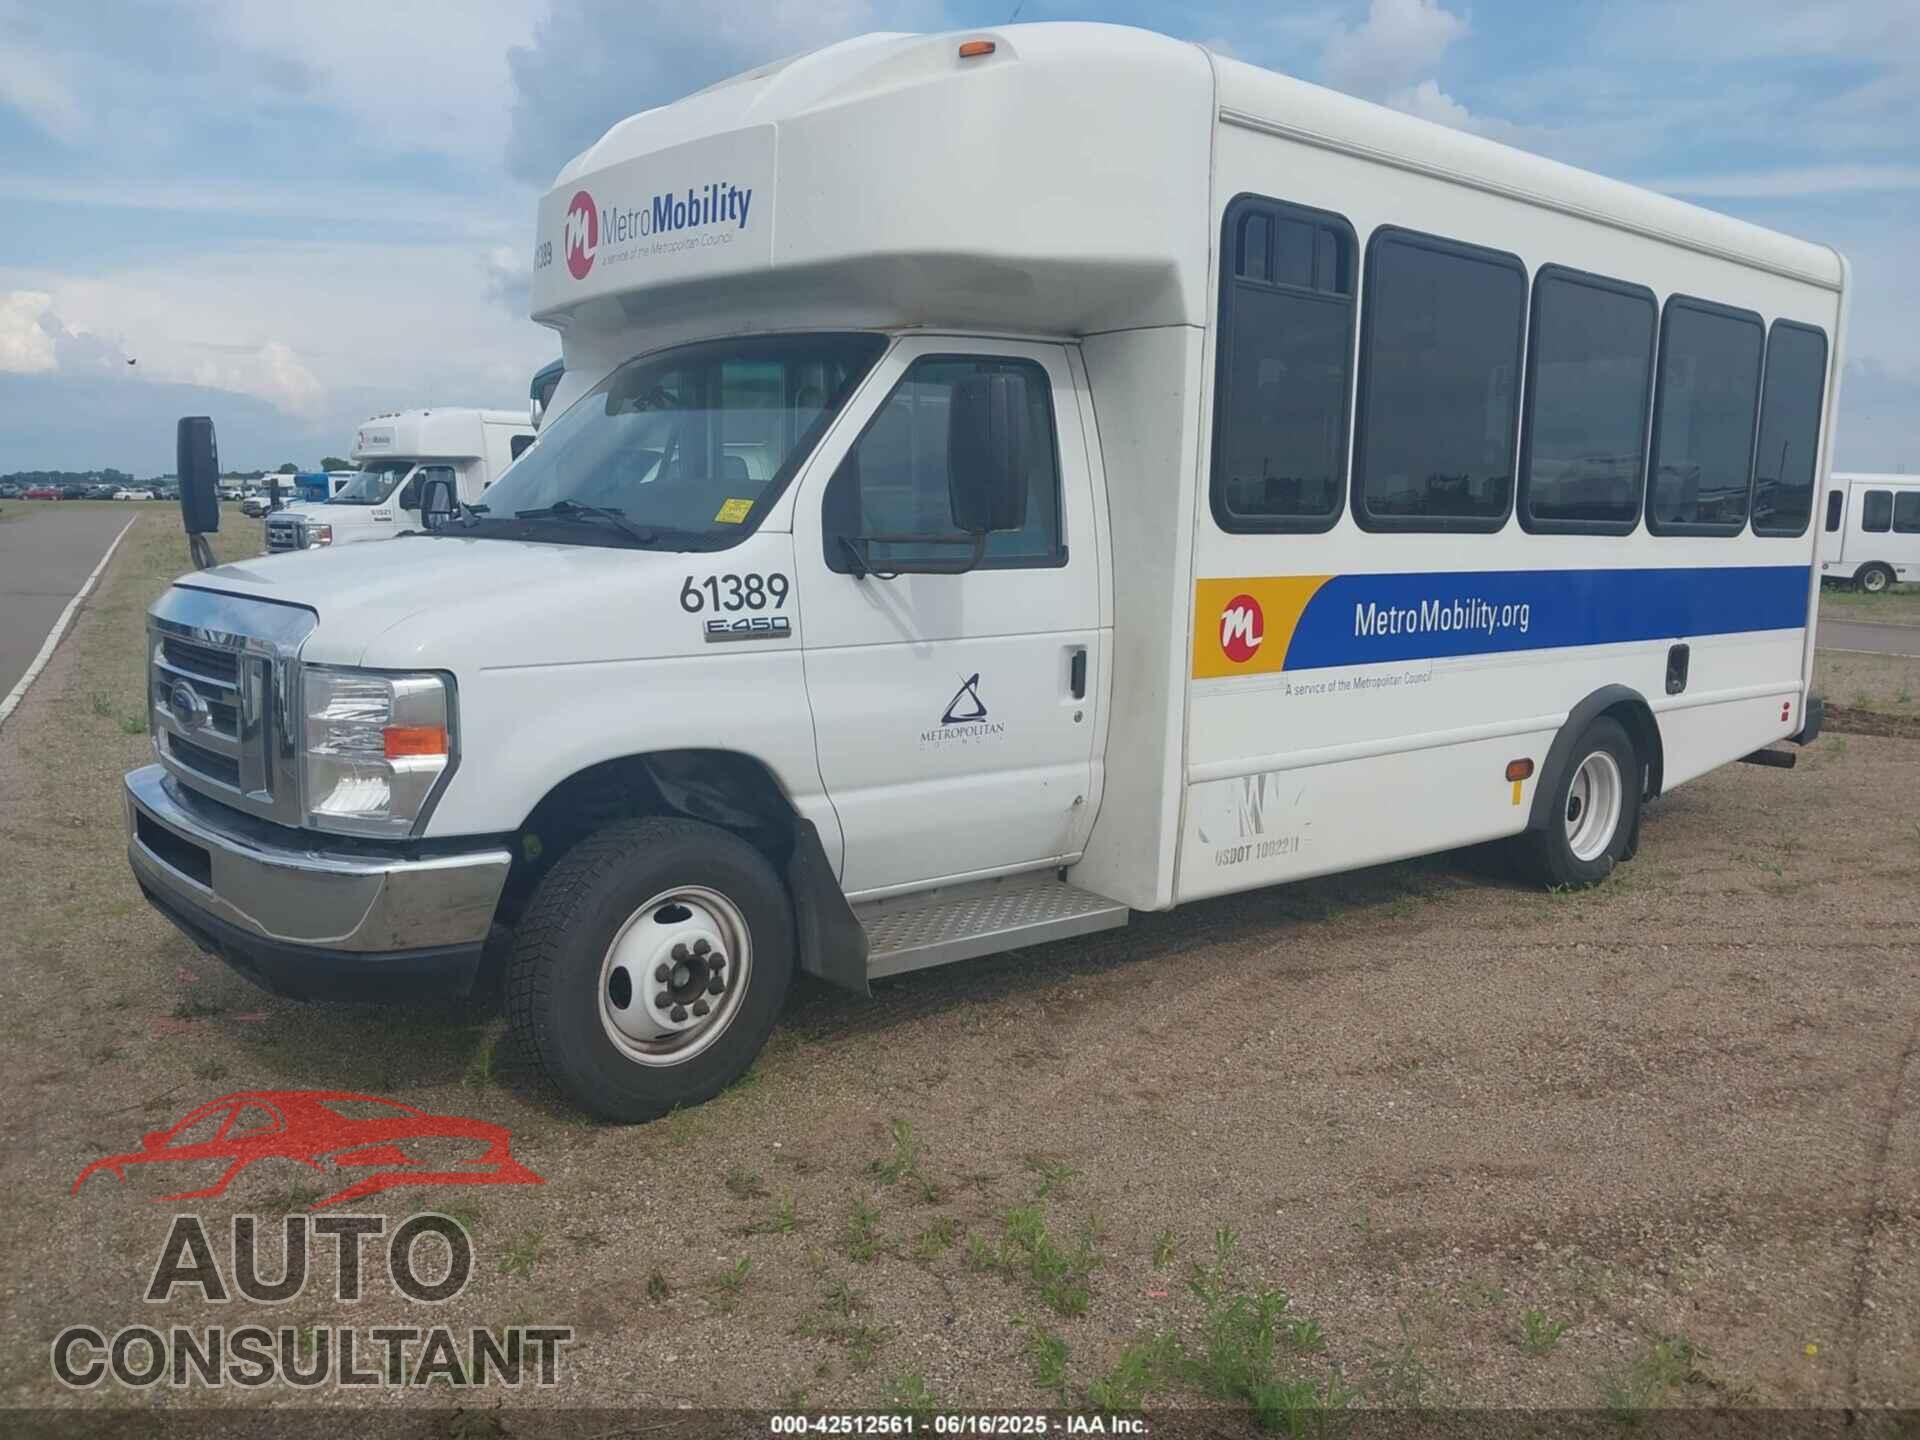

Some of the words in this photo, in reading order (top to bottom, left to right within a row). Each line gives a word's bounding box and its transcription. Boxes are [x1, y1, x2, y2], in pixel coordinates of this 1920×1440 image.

[602, 182, 752, 247] MetroMobility
[680, 573, 789, 613] 61389
[707, 617, 789, 633] E-450
[1354, 599, 1530, 637] MetroMobility.org
[1285, 683, 1292, 696] A
[1295, 682, 1325, 695] service
[1328, 680, 1337, 692] of
[1338, 679, 1350, 690] the
[1352, 673, 1402, 689] Metropolitan
[1404, 670, 1433, 685] Council
[920, 721, 1005, 742] METROPOLITAN
